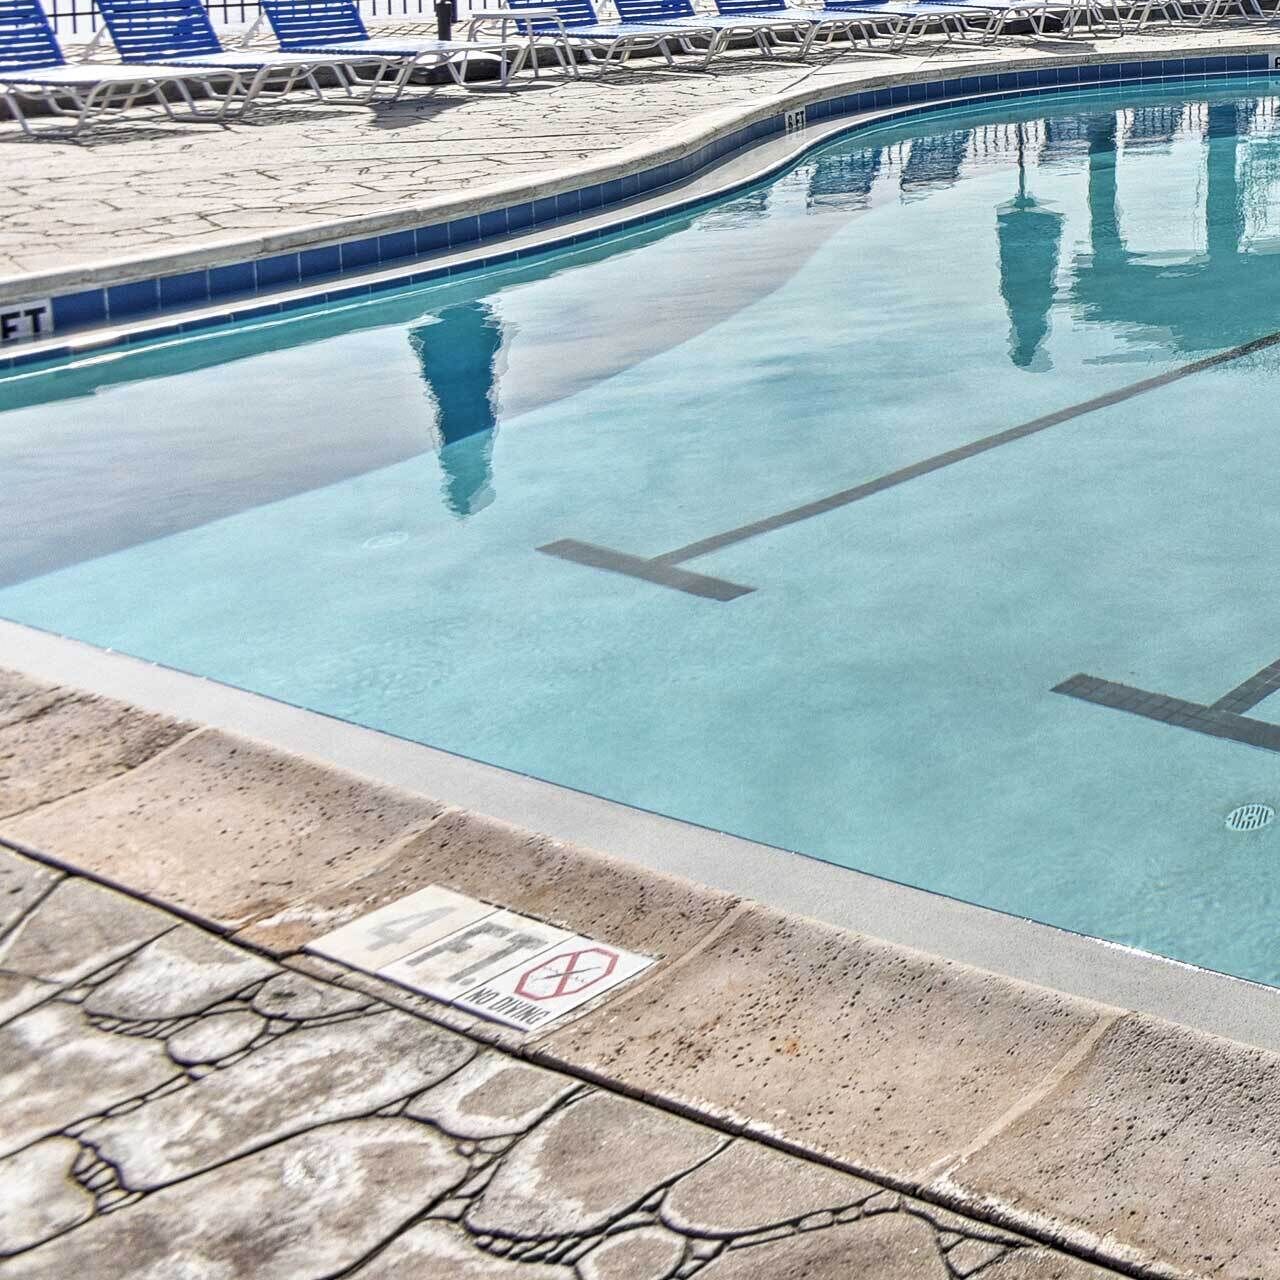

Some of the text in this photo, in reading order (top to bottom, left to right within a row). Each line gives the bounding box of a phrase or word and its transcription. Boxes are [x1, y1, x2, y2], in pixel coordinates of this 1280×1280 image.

[794, 110, 805, 128] FT
[0, 306, 47, 339] FT
[364, 905, 460, 952] 4
[464, 987, 552, 1025] NO DIVING
